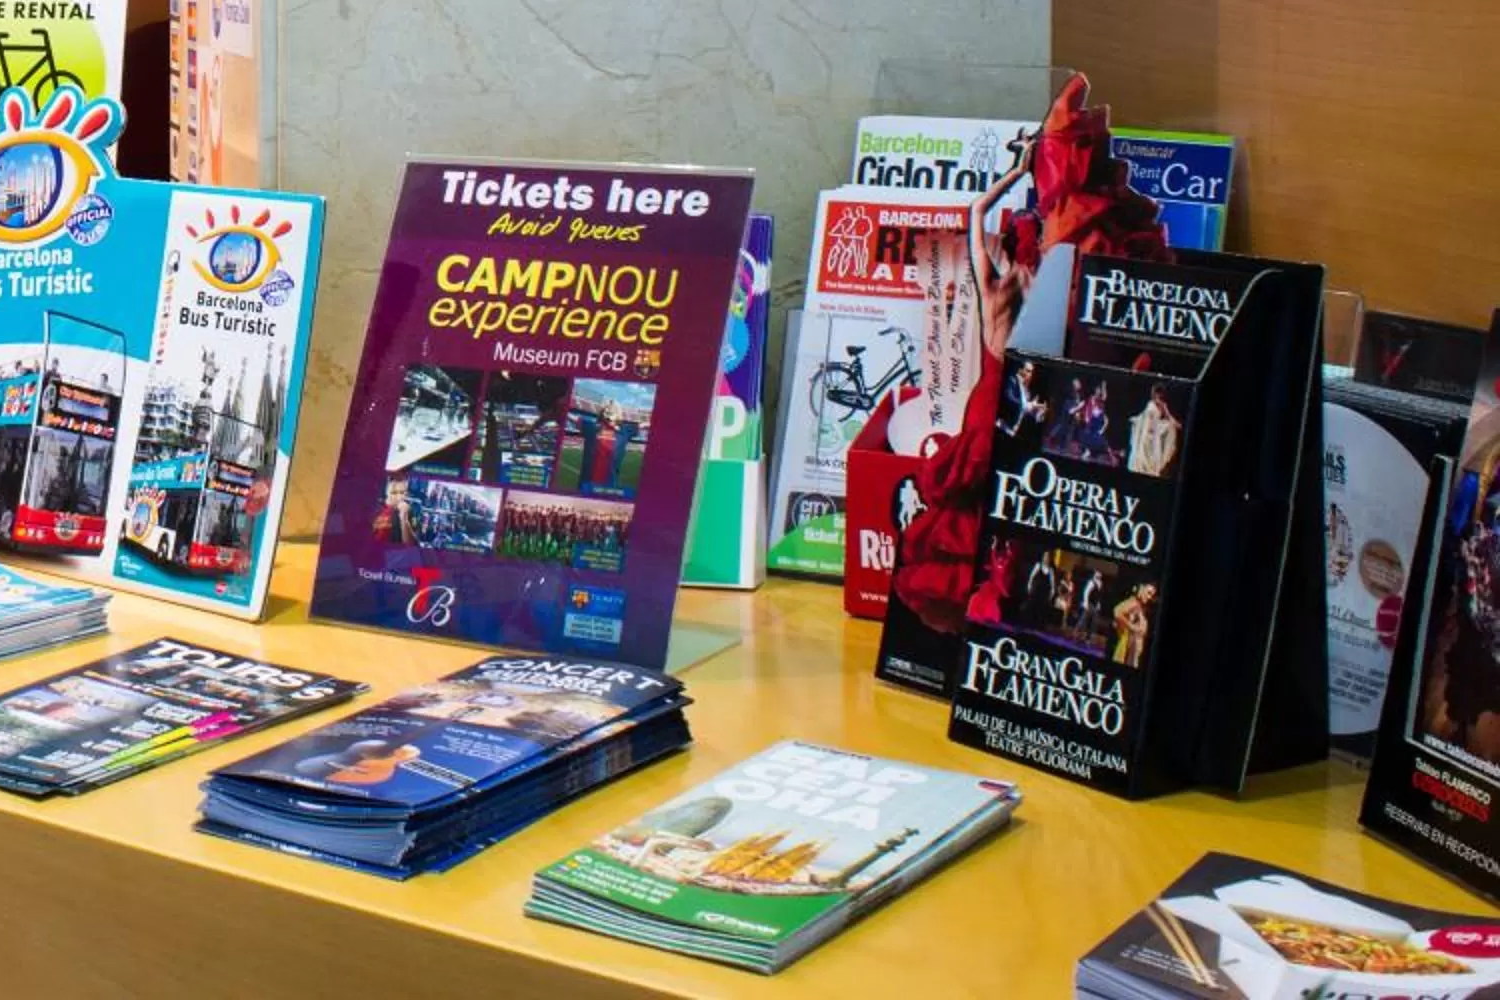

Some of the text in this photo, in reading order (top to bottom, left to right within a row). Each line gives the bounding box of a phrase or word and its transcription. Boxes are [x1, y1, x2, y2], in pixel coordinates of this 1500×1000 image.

[14, 1, 96, 20] RENTAL
[860, 131, 963, 156] Barcelona
[857, 156, 1009, 192] CicloTou
[1132, 162, 1223, 199] Rent a Car
[443, 171, 710, 217] Tickets here
[487, 211, 647, 243] Avoid queues
[879, 210, 963, 229] BARCELONA
[196, 291, 263, 313] Barcelona
[1108, 268, 1230, 310] BARCELONA
[179, 307, 209, 328] Bus
[428, 297, 670, 345] experience
[1079, 273, 1234, 345] FLAMENC
[493, 340, 627, 372] Museum FCB
[1019, 458, 1120, 516] OPERA
[989, 470, 1155, 554] FLAMENCO
[860, 529, 895, 570] Ru
[860, 592, 888, 603] www
[149, 640, 314, 688] TOURS
[479, 659, 666, 690] CONCERT
[961, 640, 1124, 735] FLAMENCO
[955, 705, 990, 728] PALAU
[991, 716, 1008, 731] DE
[1007, 721, 1022, 739] LA
[1068, 741, 1128, 773] CATALANA
[985, 731, 1092, 780] TEATRE POLIORAMA
